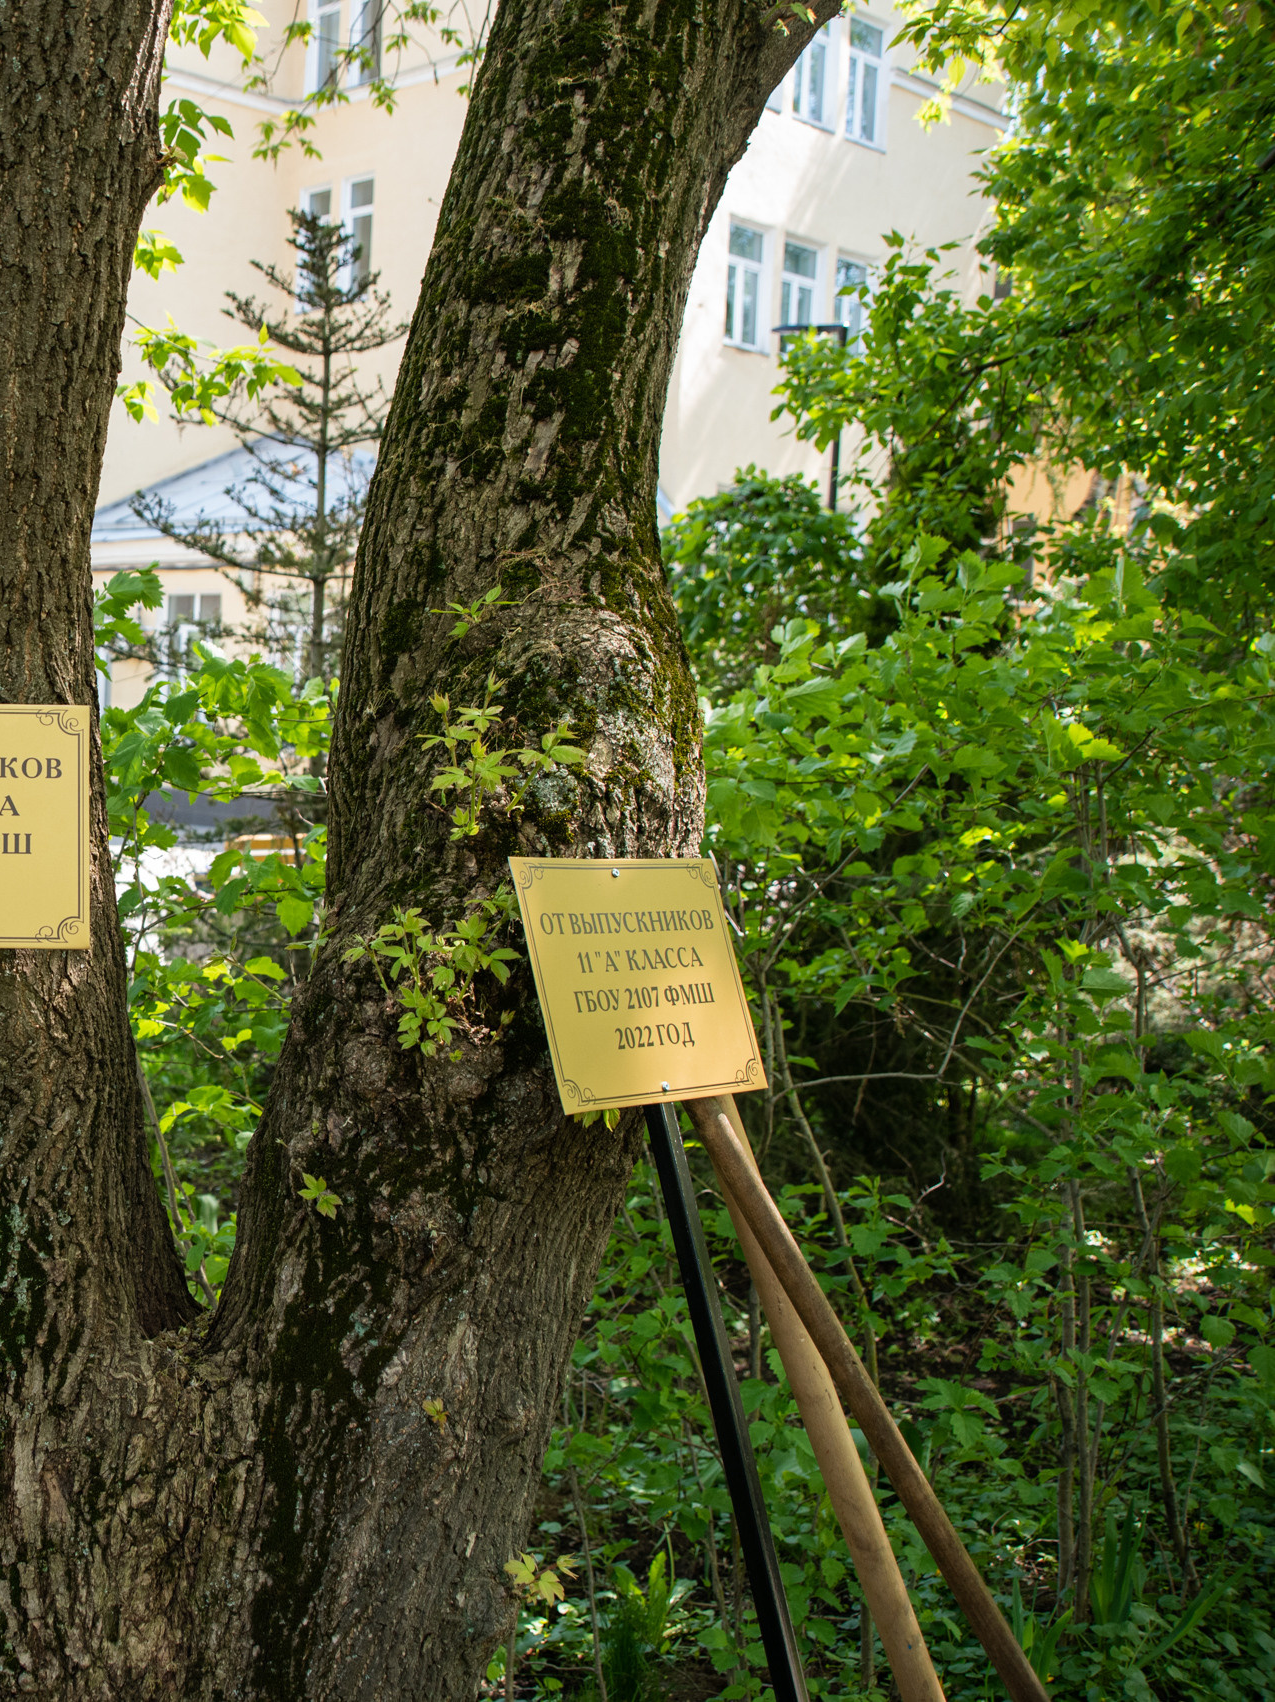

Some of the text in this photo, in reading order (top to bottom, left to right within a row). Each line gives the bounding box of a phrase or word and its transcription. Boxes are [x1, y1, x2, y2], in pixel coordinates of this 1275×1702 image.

[539, 909, 714, 935] ОТ ВЫПУСКНИКОВ
[577, 951, 593, 973] 11
[626, 946, 704, 971] КЛАССА
[574, 982, 715, 1013] ГБОУ 2107 ФМШ
[615, 1022, 695, 1050] 2022 ГОД
